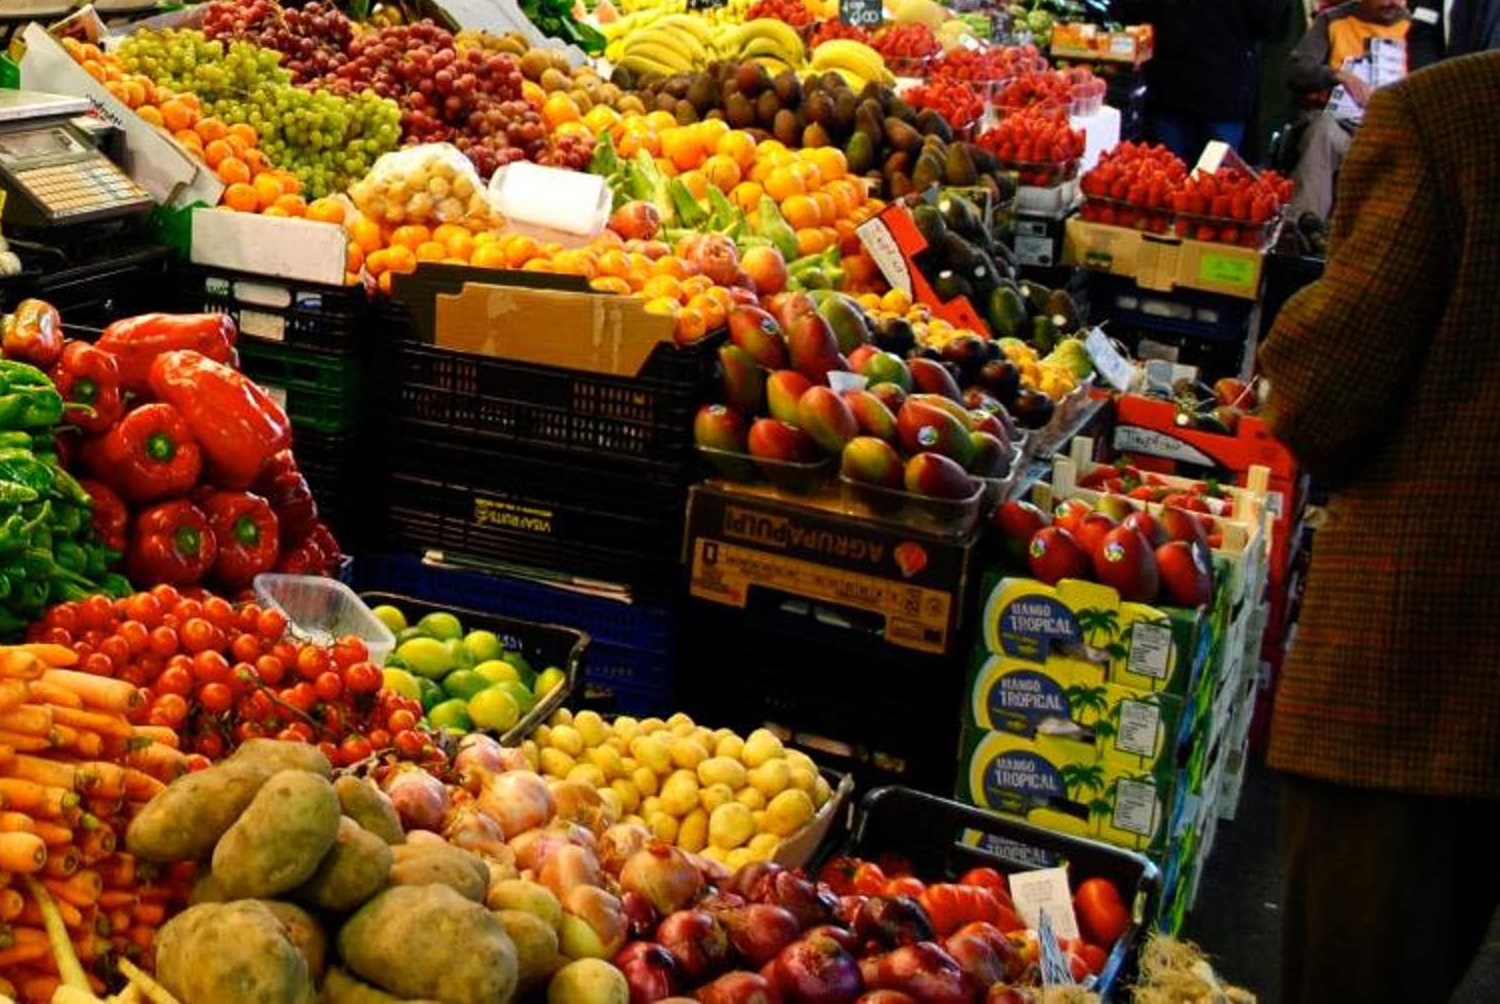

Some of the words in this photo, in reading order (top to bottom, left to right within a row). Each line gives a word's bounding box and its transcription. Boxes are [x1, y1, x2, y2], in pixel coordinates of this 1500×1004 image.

[1010, 615, 1074, 635] TROPICAL
[999, 690, 1062, 711] TROPICAL
[995, 770, 1058, 791] TROPICAL
